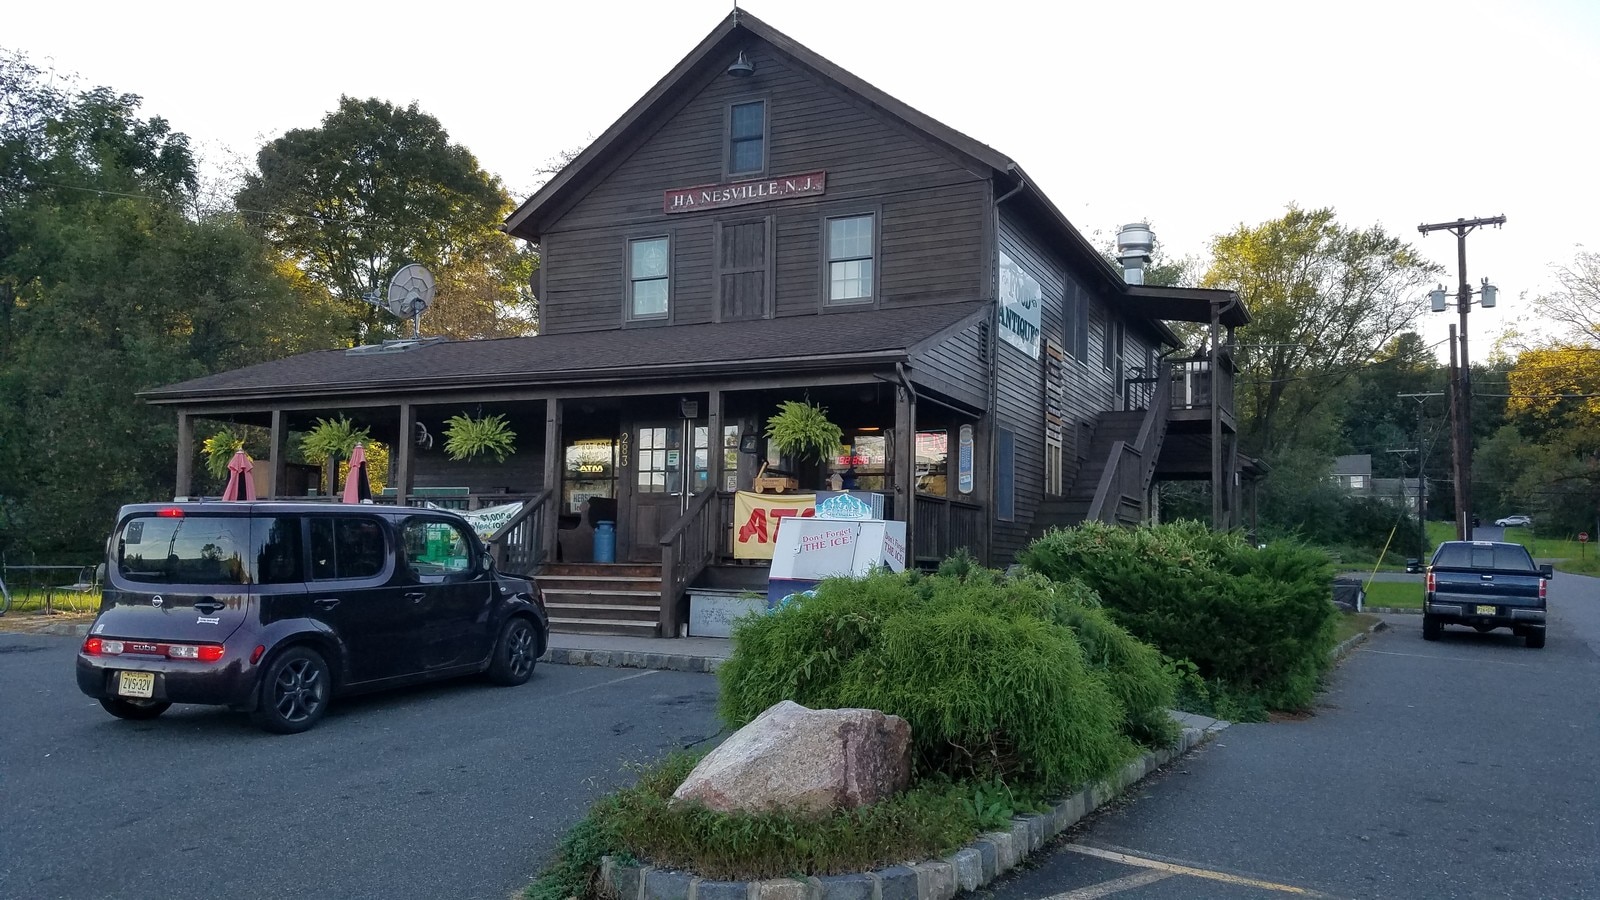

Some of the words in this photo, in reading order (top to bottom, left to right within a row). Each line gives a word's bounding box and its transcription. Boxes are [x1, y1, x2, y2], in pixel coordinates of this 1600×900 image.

[580, 465, 603, 473] ATM
[738, 508, 815, 543] AT
[826, 527, 852, 539] Forget
[802, 541, 827, 552] THE
[830, 535, 853, 548] ICE!
[884, 541, 895, 557] THE
[133, 644, 157, 652] cube
